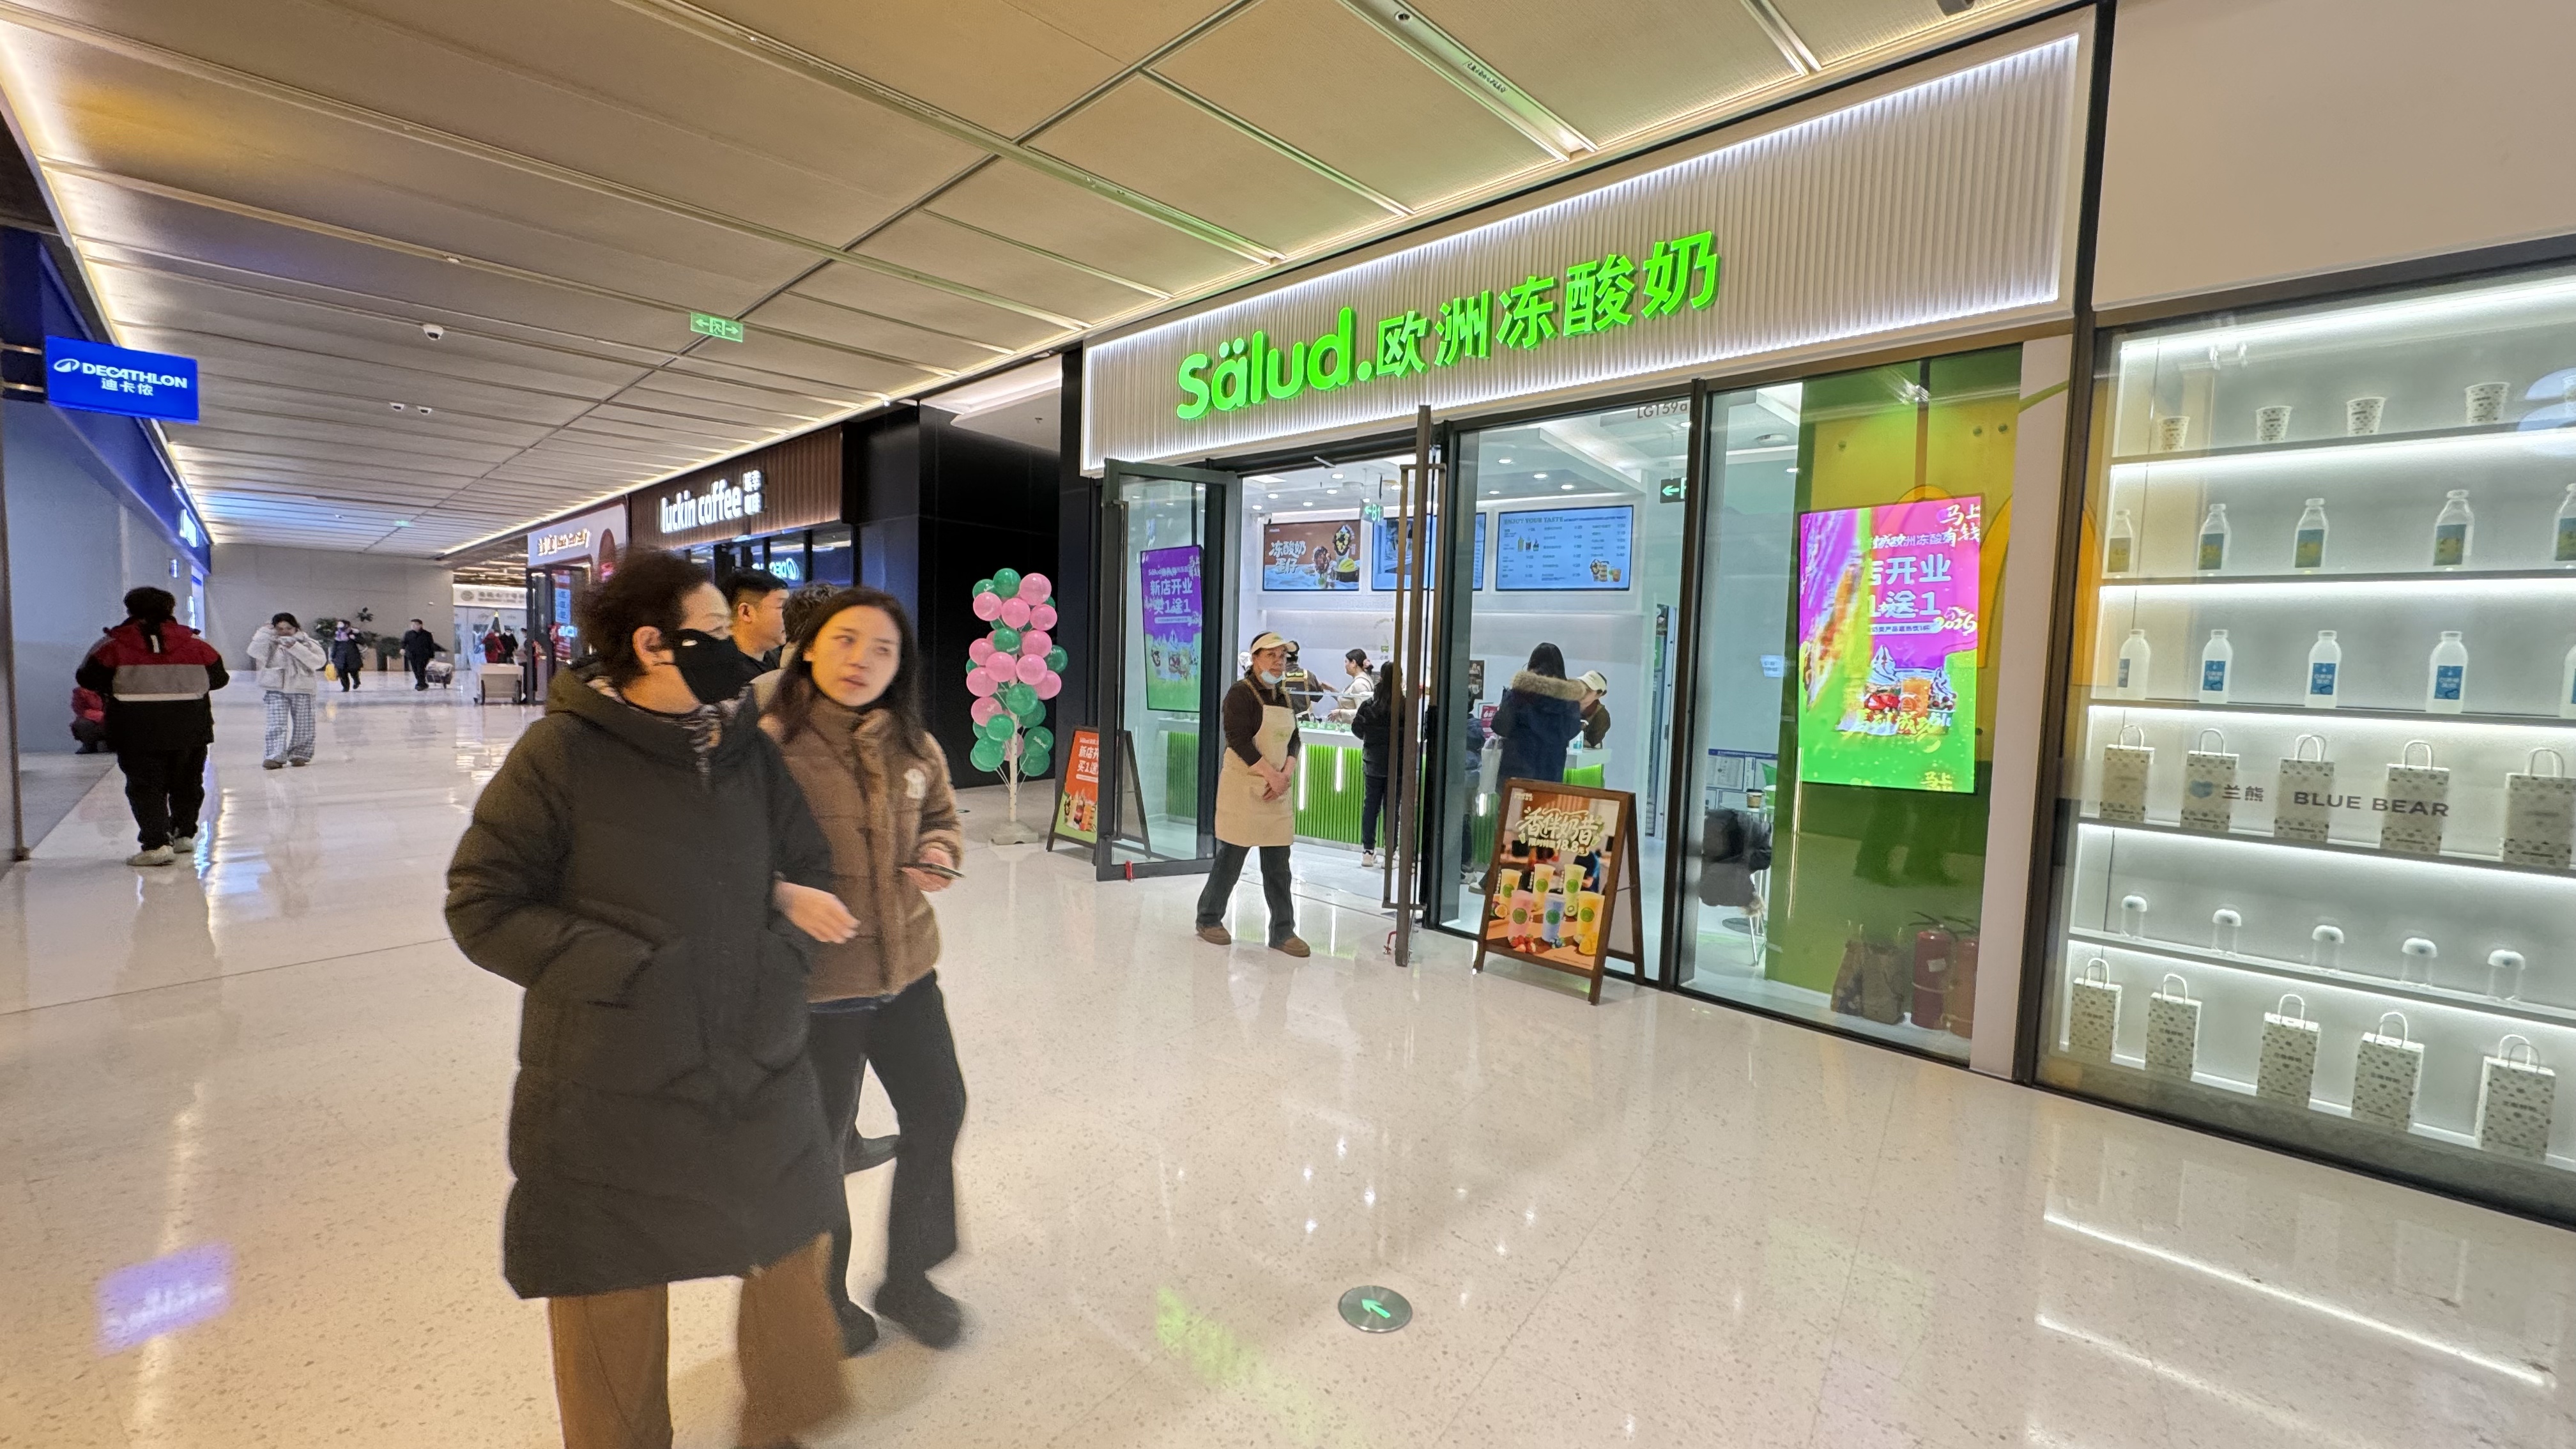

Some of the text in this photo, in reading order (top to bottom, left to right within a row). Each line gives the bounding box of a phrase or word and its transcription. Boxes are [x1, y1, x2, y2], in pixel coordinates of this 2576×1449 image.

[1376, 230, 1721, 378] 欧洲冻酸奶
[82, 362, 188, 389] DECATHLON
[101, 378, 154, 396] 迪卡侬
[660, 479, 744, 533] luckin coffee
[1372, 503, 1381, 523] B1
[1268, 540, 1307, 558] 冻酸奶
[1275, 557, 1298, 574] 蛋仔
[1150, 577, 1193, 596] 新店开业
[2222, 784, 2264, 802] 兰熊
[2294, 791, 2450, 817] BLUE BEAR
